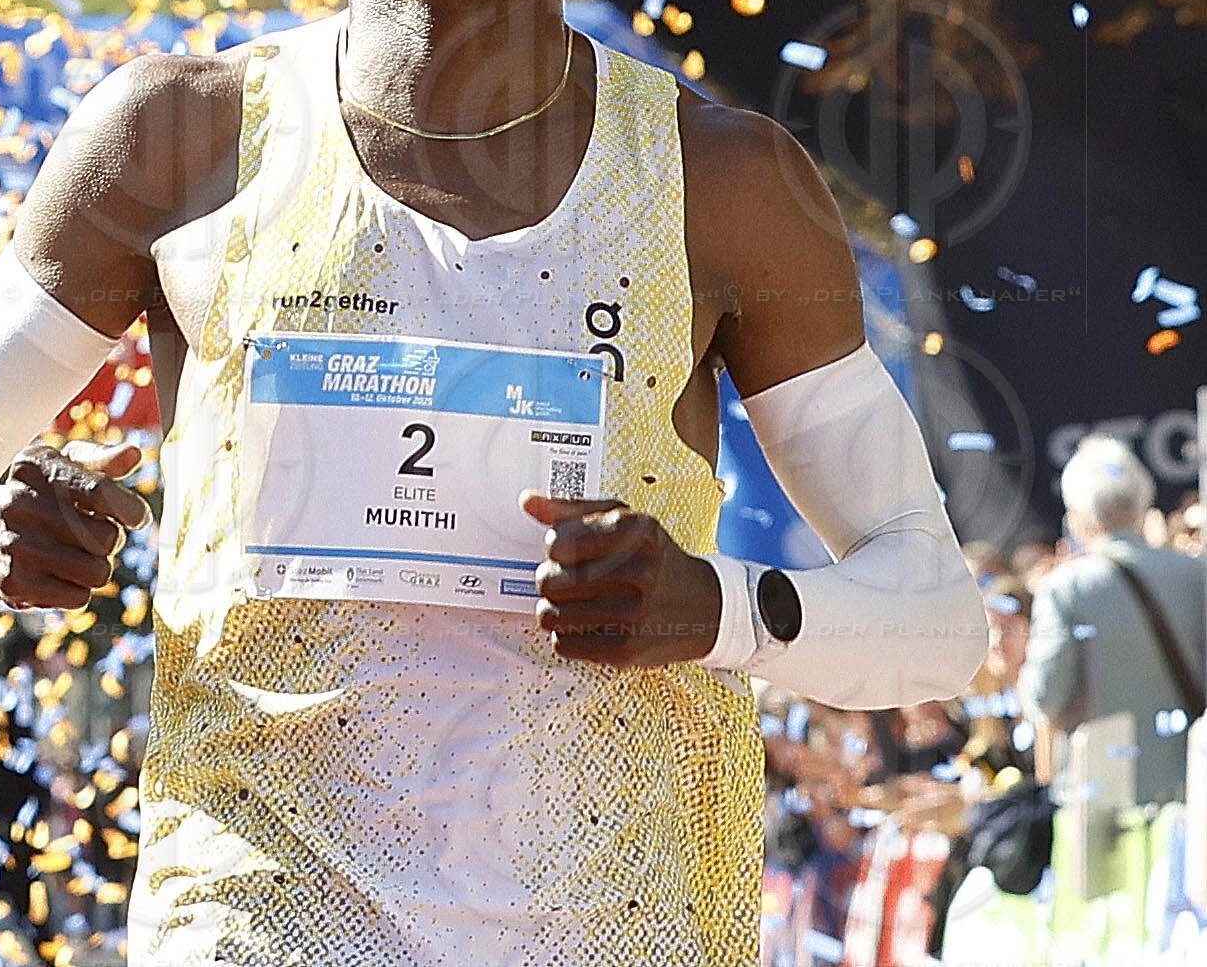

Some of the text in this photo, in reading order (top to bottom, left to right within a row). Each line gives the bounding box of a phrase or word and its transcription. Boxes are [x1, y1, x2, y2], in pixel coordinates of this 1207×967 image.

[327, 354, 381, 373] GRAZ
[322, 373, 437, 395] MARATHON
[398, 423, 435, 477] 2
[394, 486, 436, 501] ELITE
[366, 508, 456, 530] MURITHI
